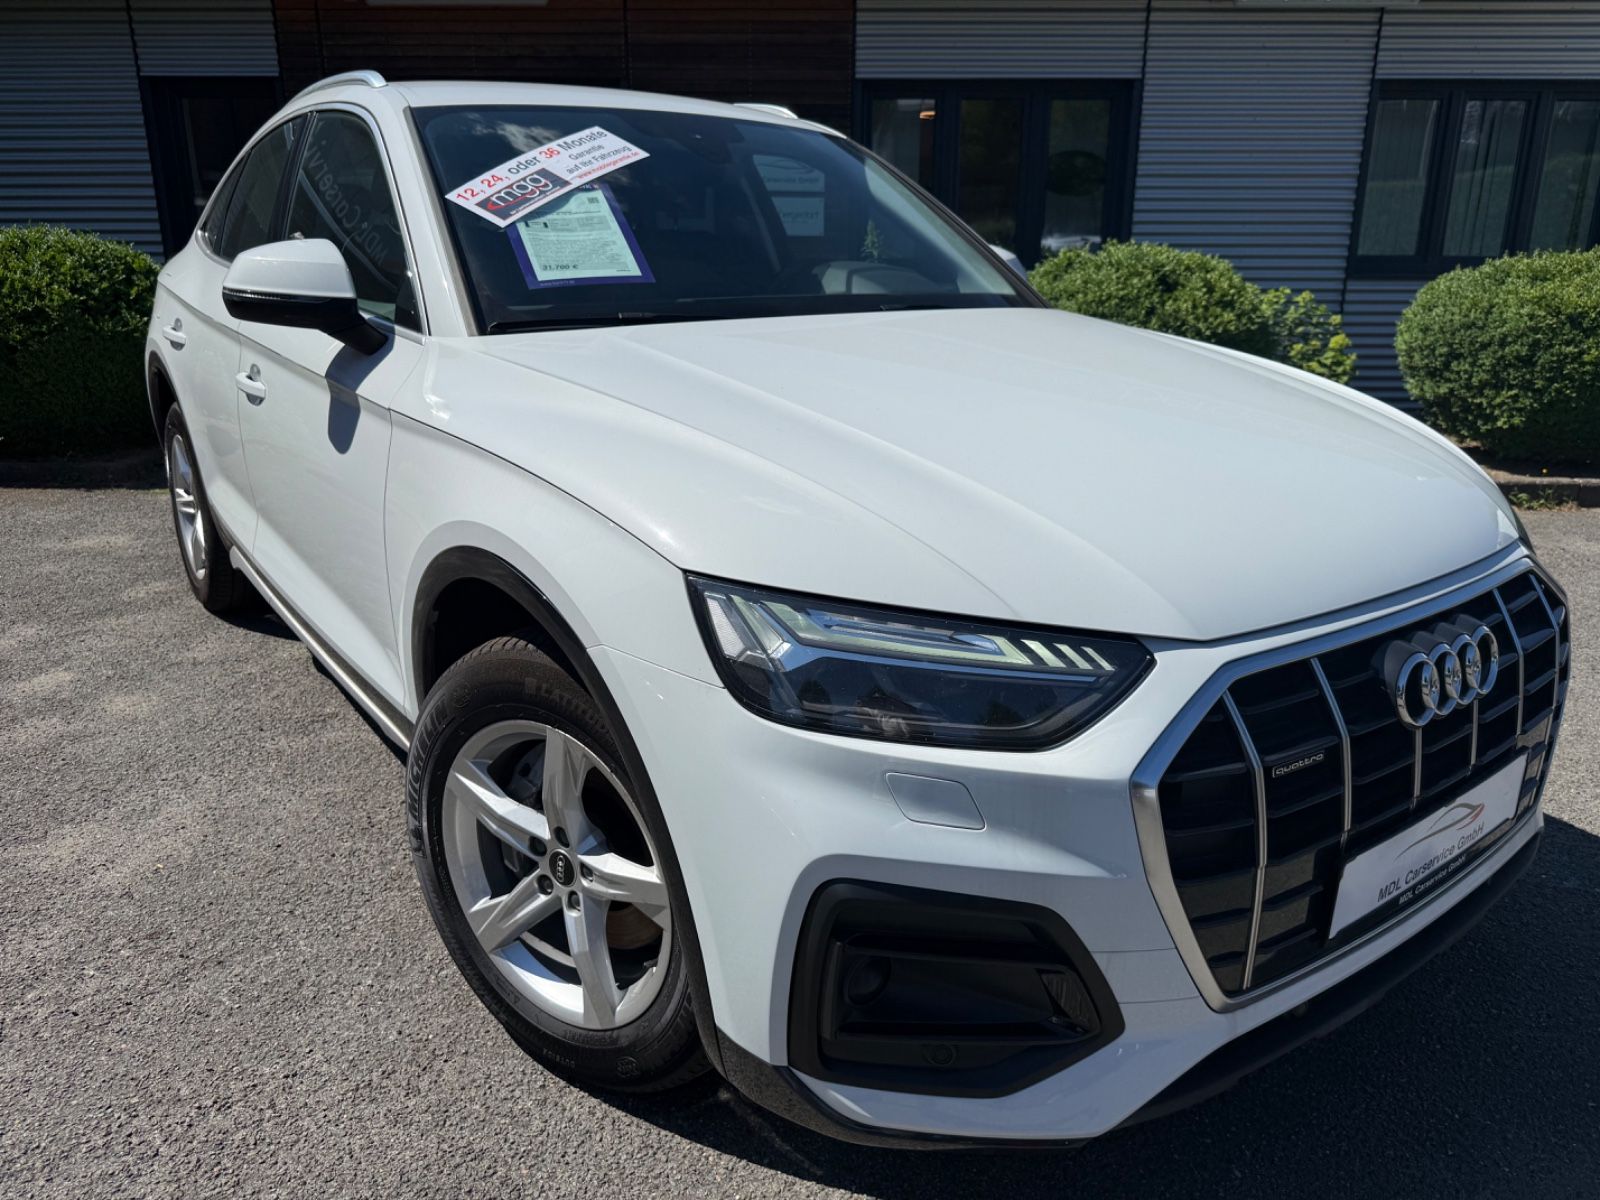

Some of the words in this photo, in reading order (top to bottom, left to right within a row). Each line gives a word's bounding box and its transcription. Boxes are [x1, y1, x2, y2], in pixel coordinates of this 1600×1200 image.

[456, 187, 486, 202] 12,
[480, 174, 511, 189] 24,
[507, 155, 542, 175] oder
[539, 147, 561, 160] 36
[557, 129, 609, 153] Monate
[568, 144, 605, 161] Garantie
[592, 145, 633, 163] Fahrzeug
[490, 173, 553, 206] mgg
[408, 695, 451, 821] MICHELIN
[1274, 753, 1324, 775] quattro
[1377, 877, 1402, 902] MDL
[1404, 845, 1455, 885] Carservice
[1457, 821, 1485, 850] GmbH
[1399, 887, 1414, 905] MDL
[1415, 867, 1447, 894] Carservice
[1447, 854, 1467, 872] GmbH
